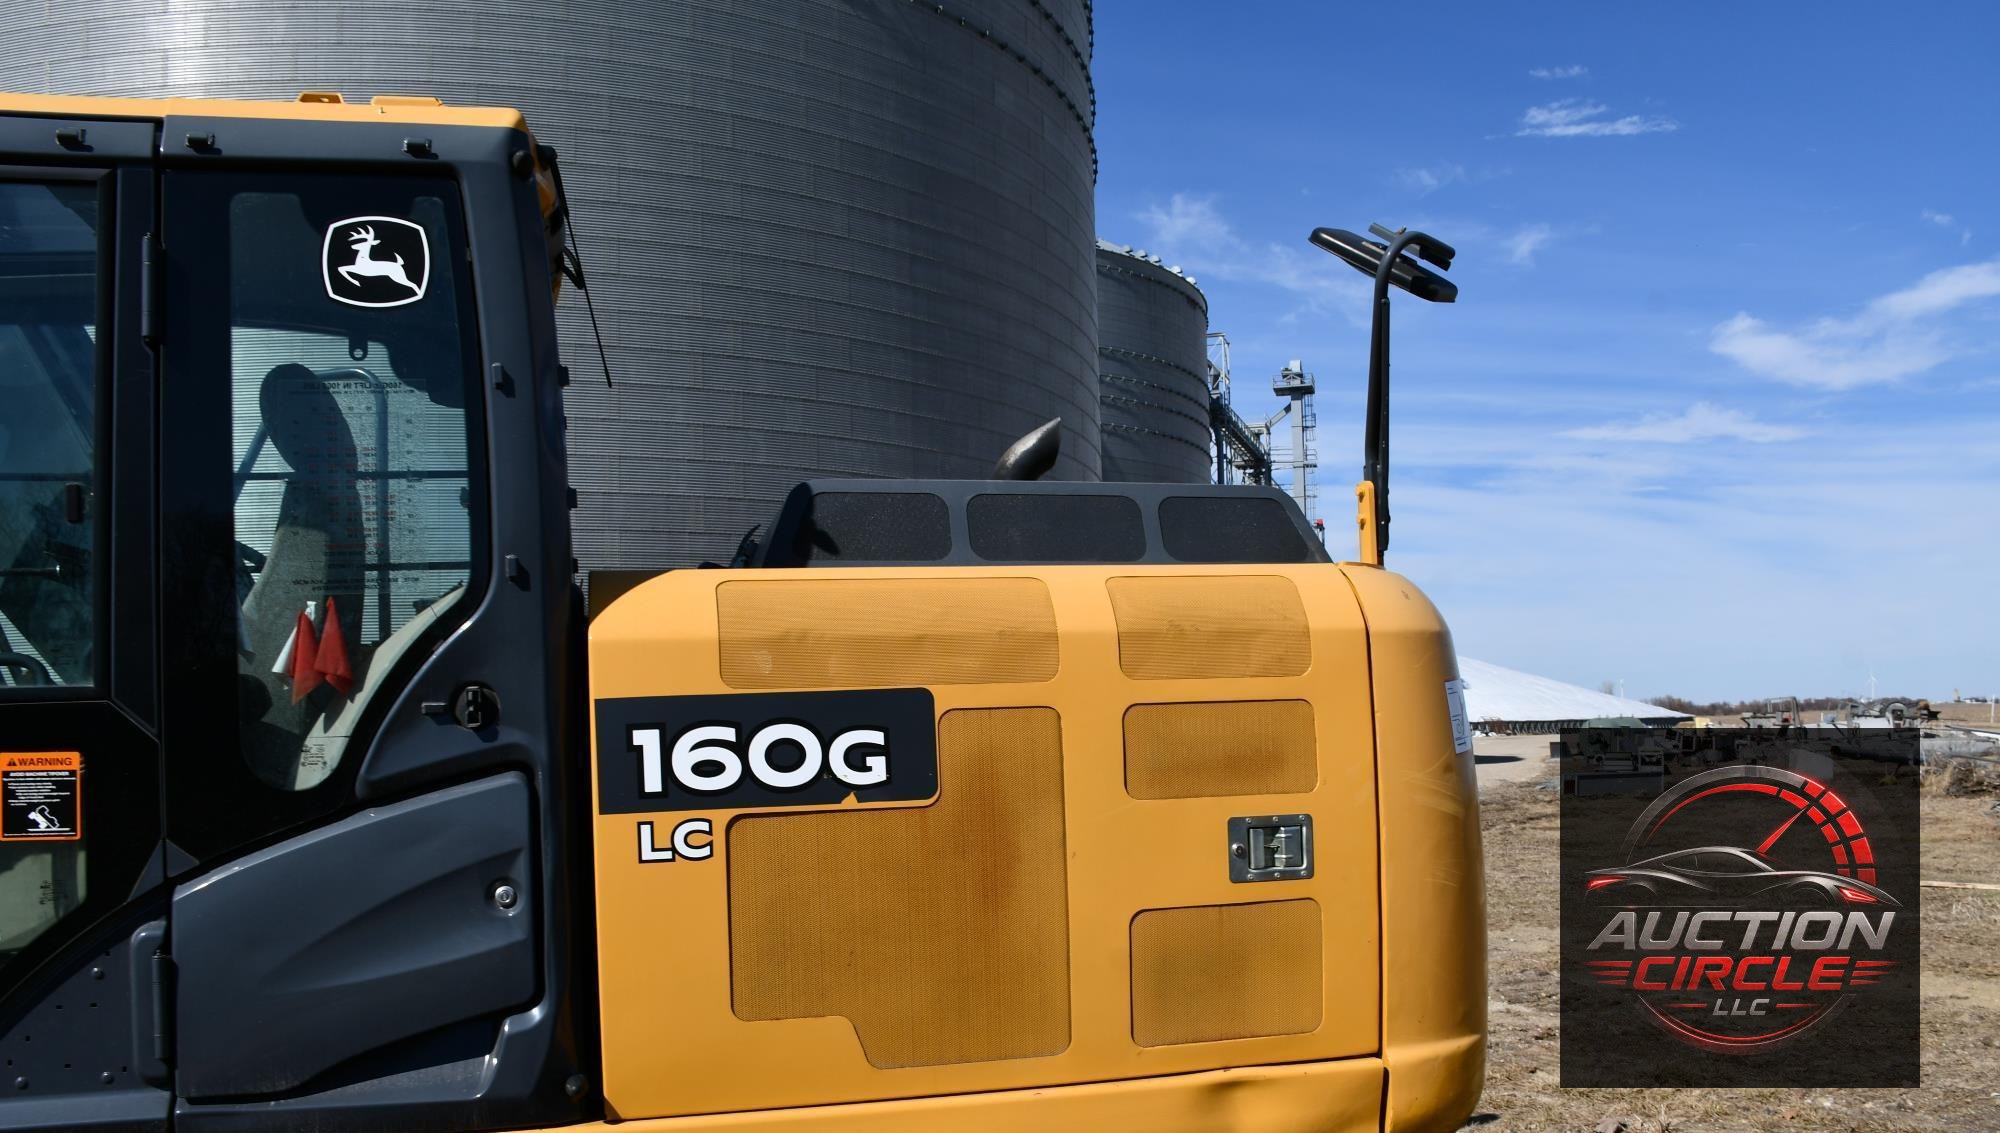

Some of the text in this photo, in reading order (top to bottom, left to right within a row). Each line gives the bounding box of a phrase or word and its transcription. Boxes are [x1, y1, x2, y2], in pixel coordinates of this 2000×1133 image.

[18, 757, 72, 766] WARNING
[632, 723, 887, 793] 160G
[639, 820, 711, 862] LC
